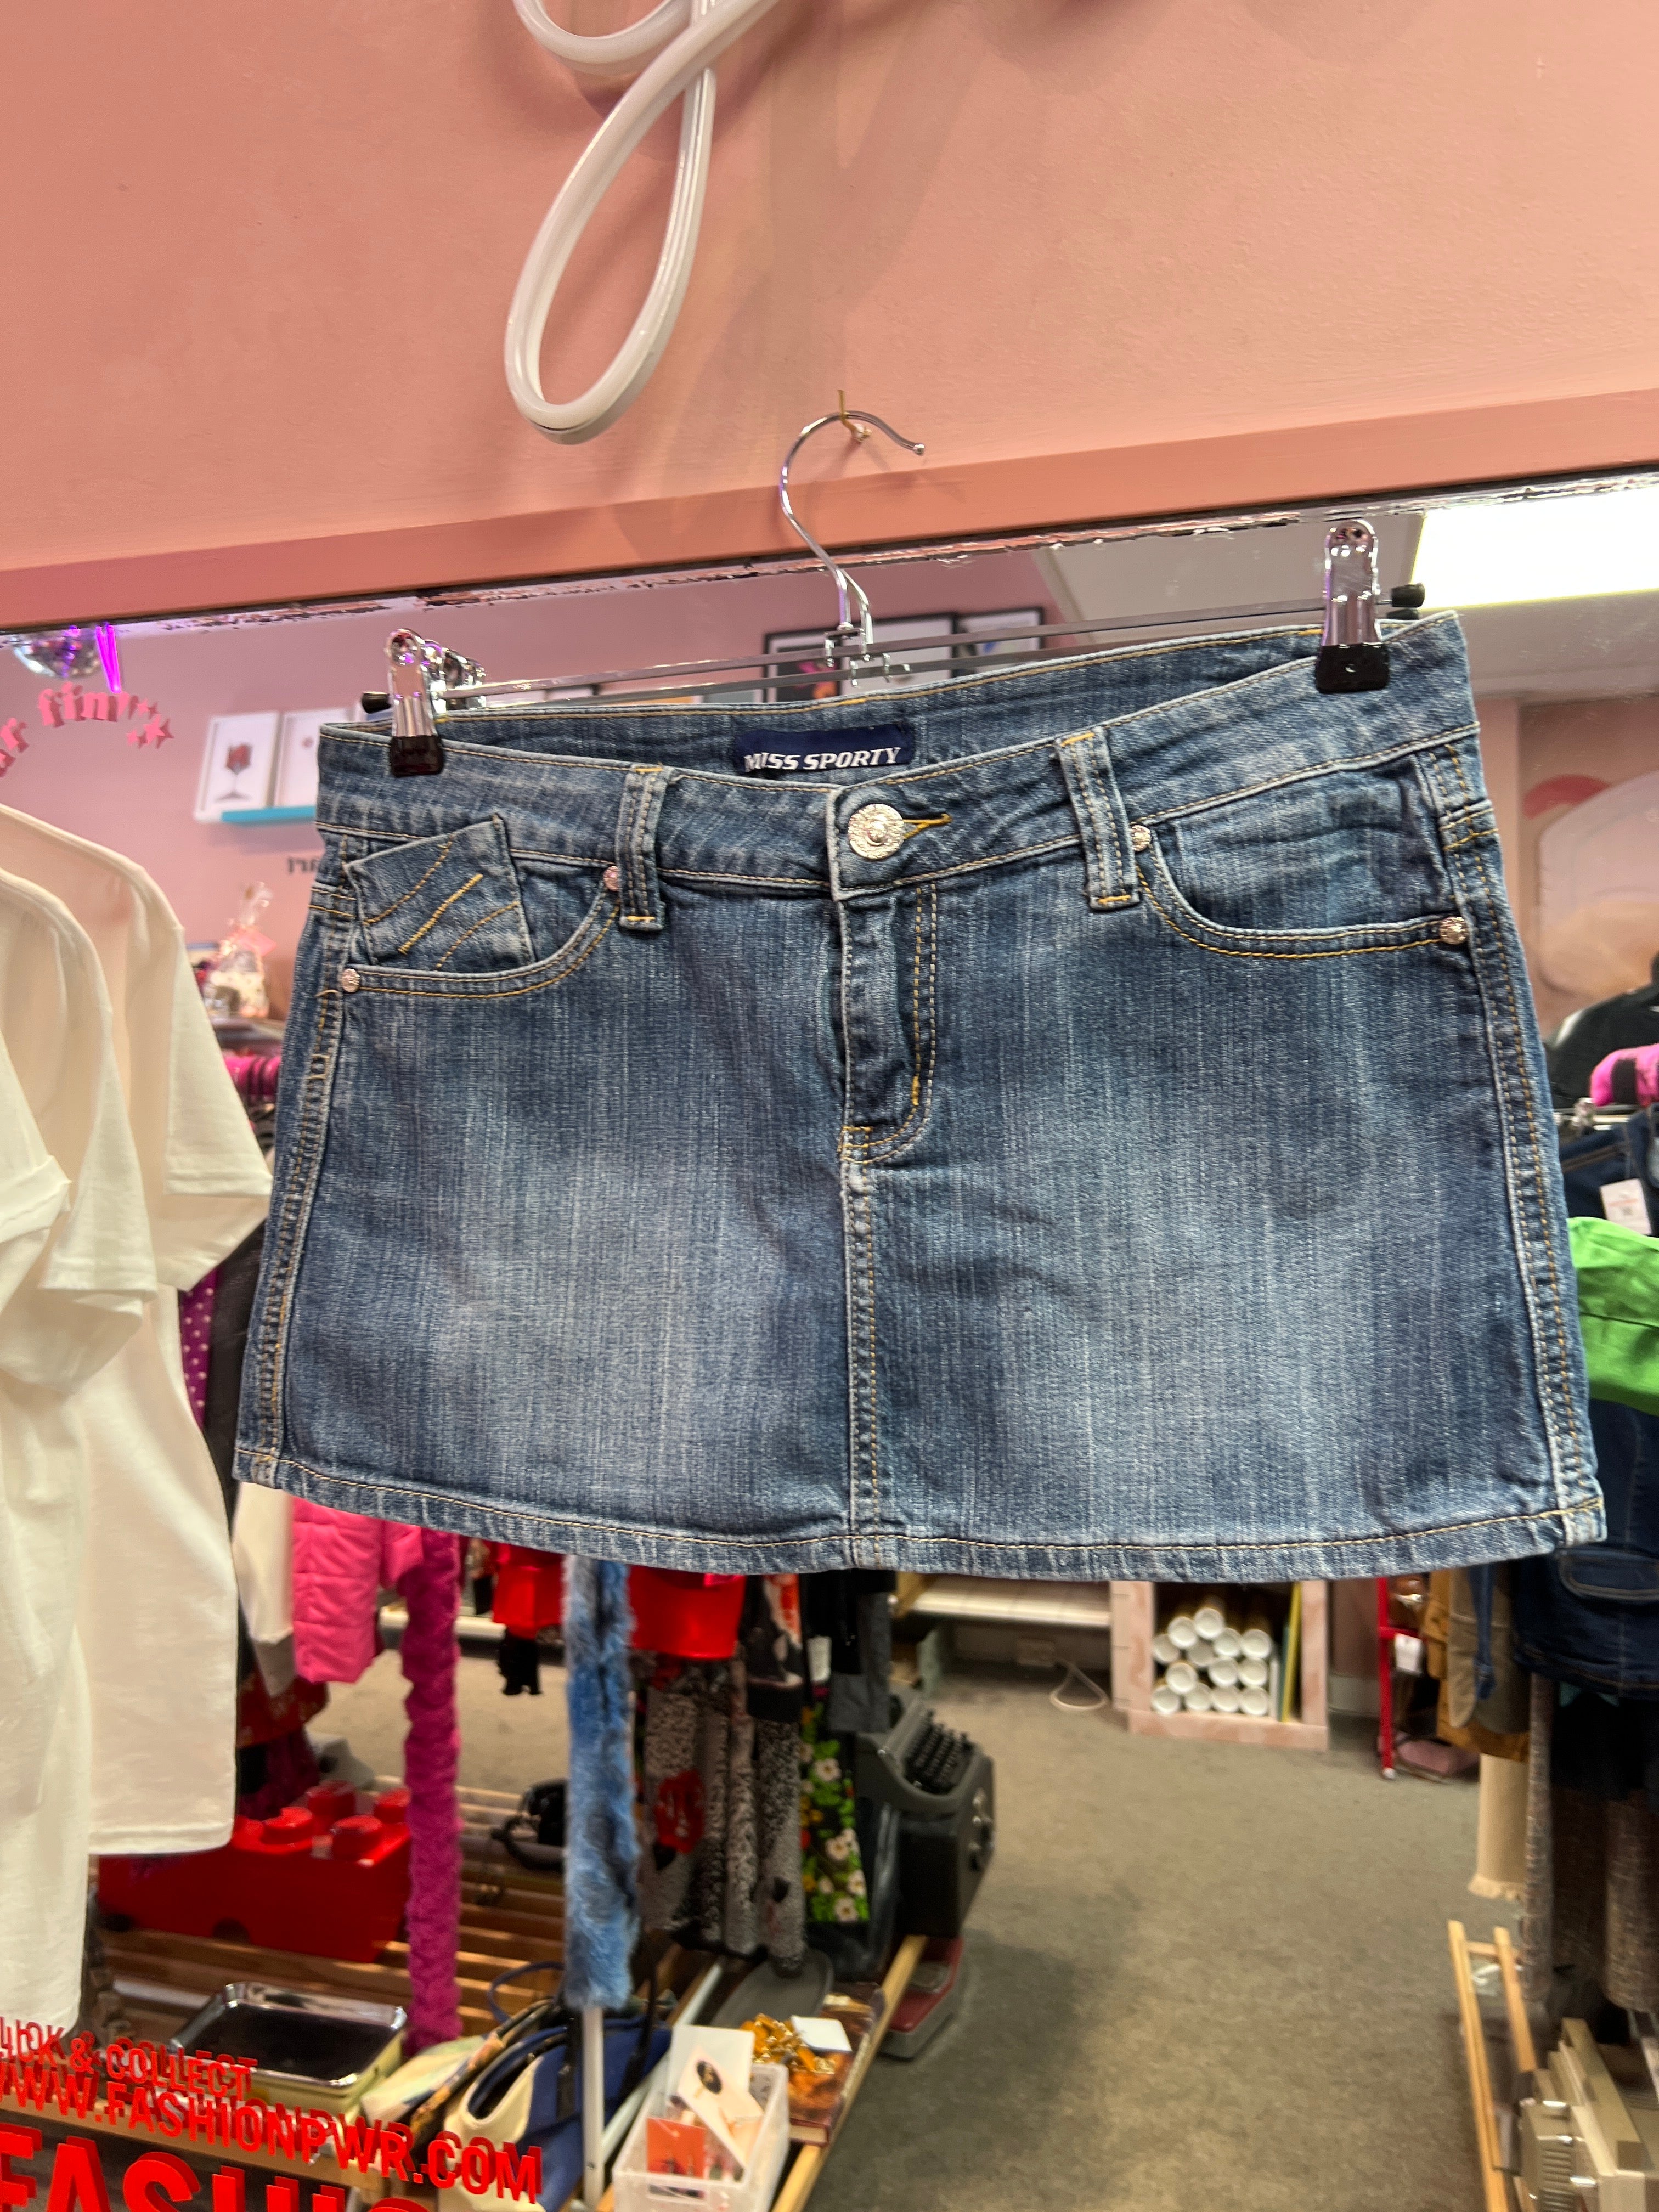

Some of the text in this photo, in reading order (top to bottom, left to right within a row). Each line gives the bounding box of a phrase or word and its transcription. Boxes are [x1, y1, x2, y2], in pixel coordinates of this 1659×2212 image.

[744, 747, 901, 772] MISS SPORTY
[70, 2038, 94, 2074] &
[106, 2044, 251, 2102] COLLECT
